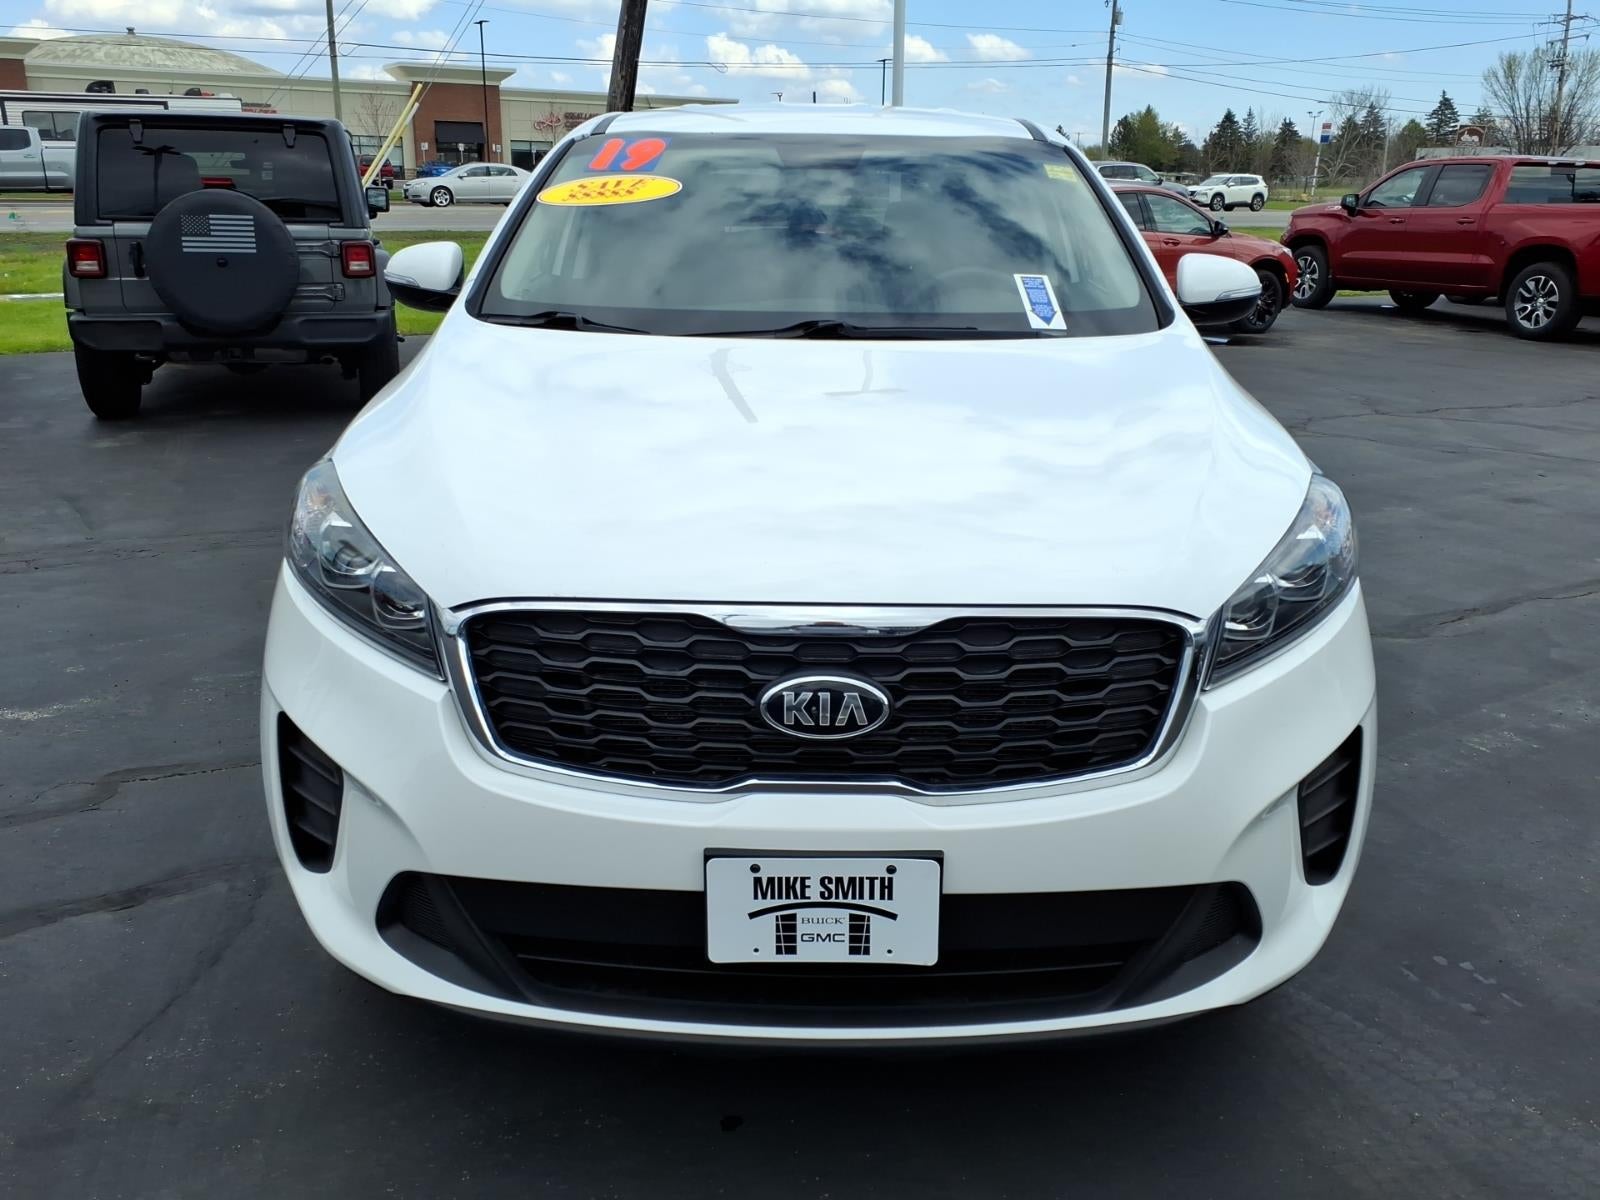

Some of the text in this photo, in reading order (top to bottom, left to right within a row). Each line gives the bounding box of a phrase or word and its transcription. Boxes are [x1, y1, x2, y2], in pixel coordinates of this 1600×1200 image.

[588, 138, 666, 171] 19
[782, 691, 868, 726] KIA
[753, 876, 893, 901] MIKE SMITH
[801, 917, 843, 925] BUICK
[800, 933, 845, 943] GMC
